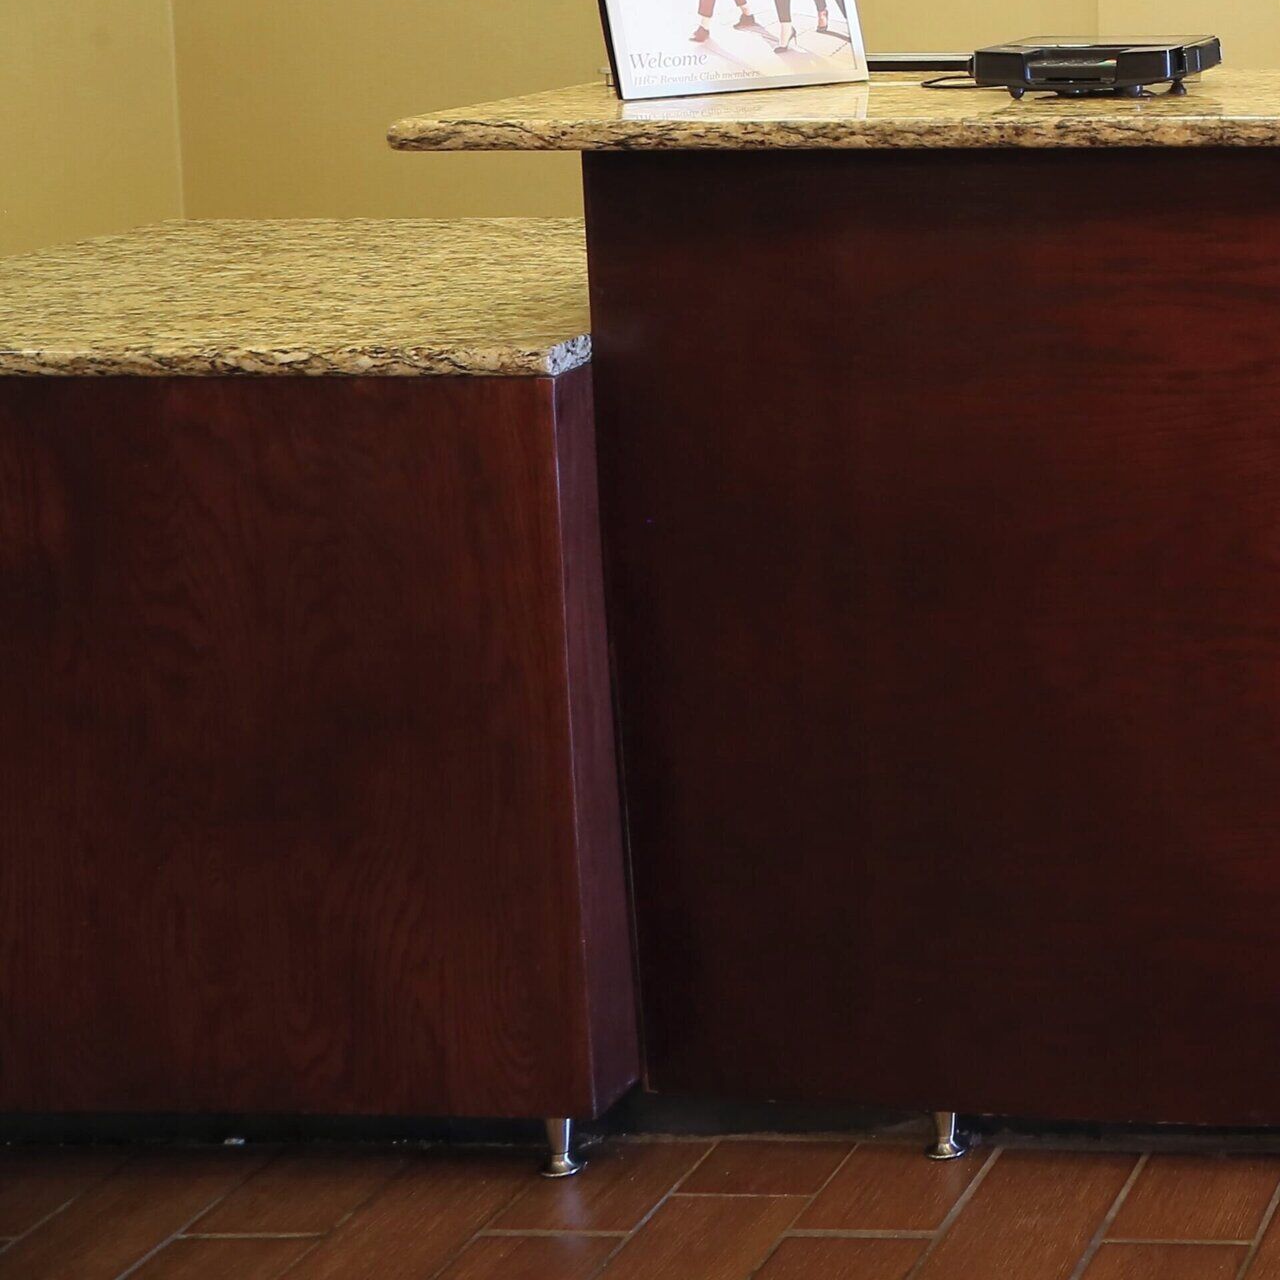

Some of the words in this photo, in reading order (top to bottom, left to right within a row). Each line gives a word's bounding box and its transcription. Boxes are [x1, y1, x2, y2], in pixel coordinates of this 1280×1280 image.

[629, 51, 708, 70] Welcome
[660, 72, 698, 84] Rewards
[699, 70, 721, 81] Club
